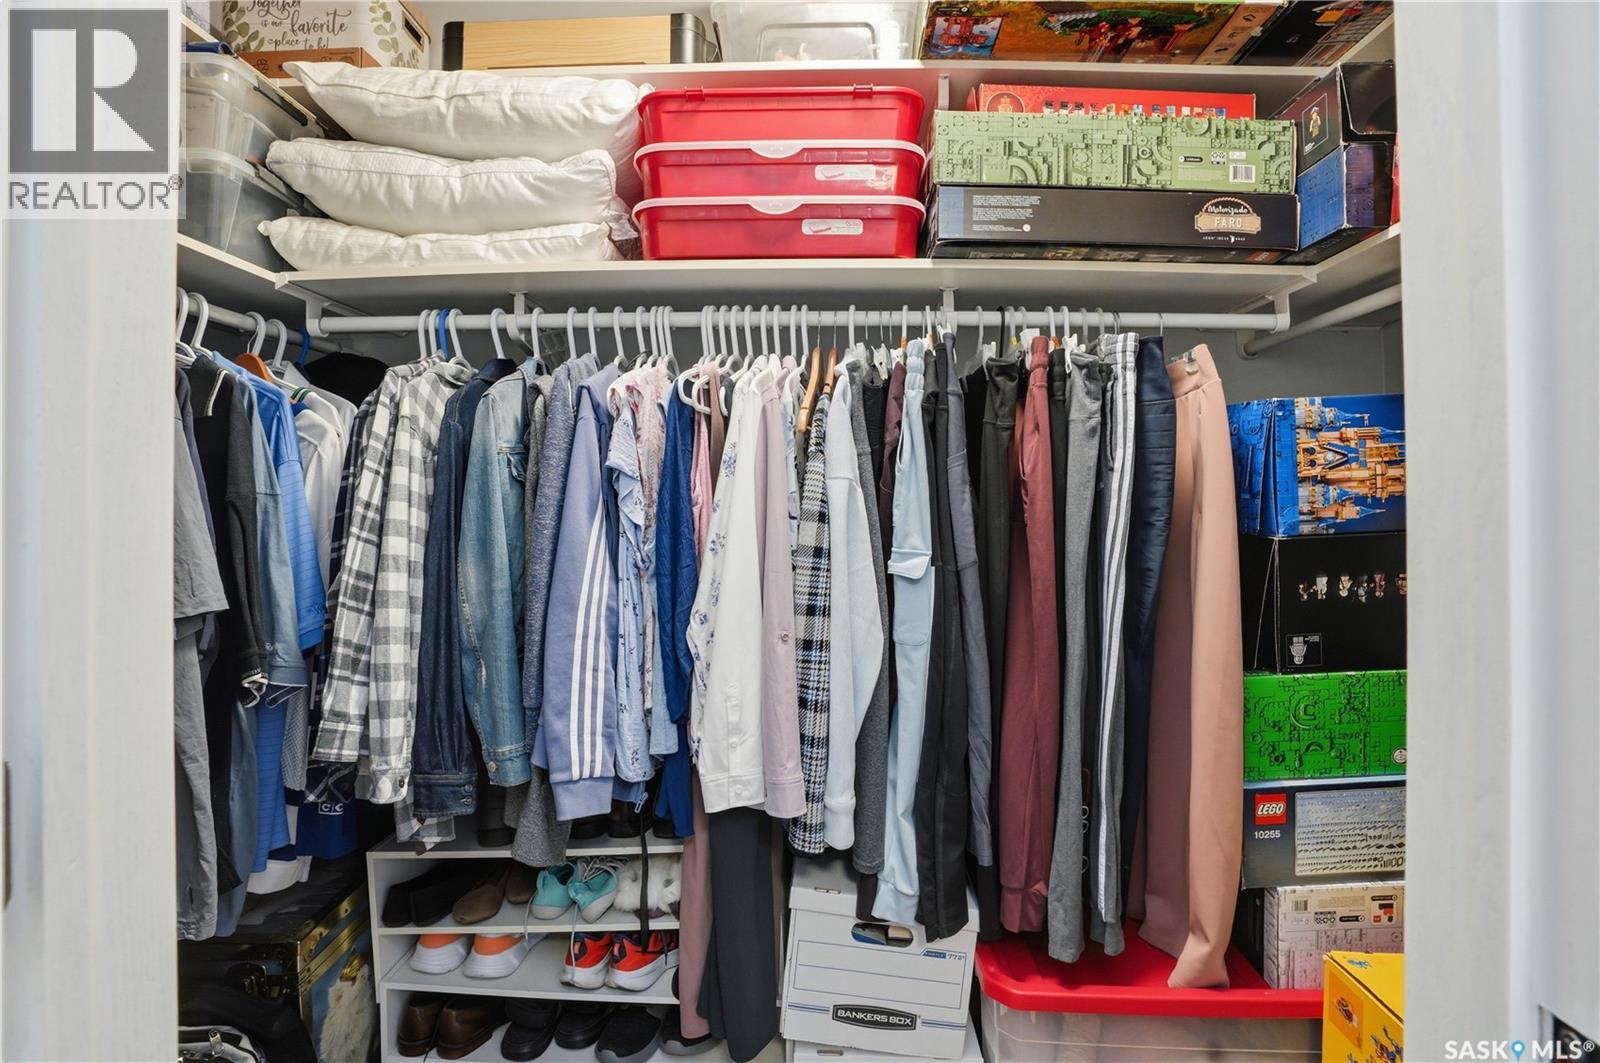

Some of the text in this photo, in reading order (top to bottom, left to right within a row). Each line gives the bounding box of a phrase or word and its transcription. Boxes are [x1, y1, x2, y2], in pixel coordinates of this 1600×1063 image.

[289, 8, 352, 36] favorite
[267, 31, 299, 50] place
[1208, 205, 1248, 216] Motorizado
[1215, 217, 1242, 228] FARO
[1257, 803, 1284, 815] LEGO
[1254, 830, 1281, 839] 10255
[837, 1009, 912, 1026] BANKERS BOX
